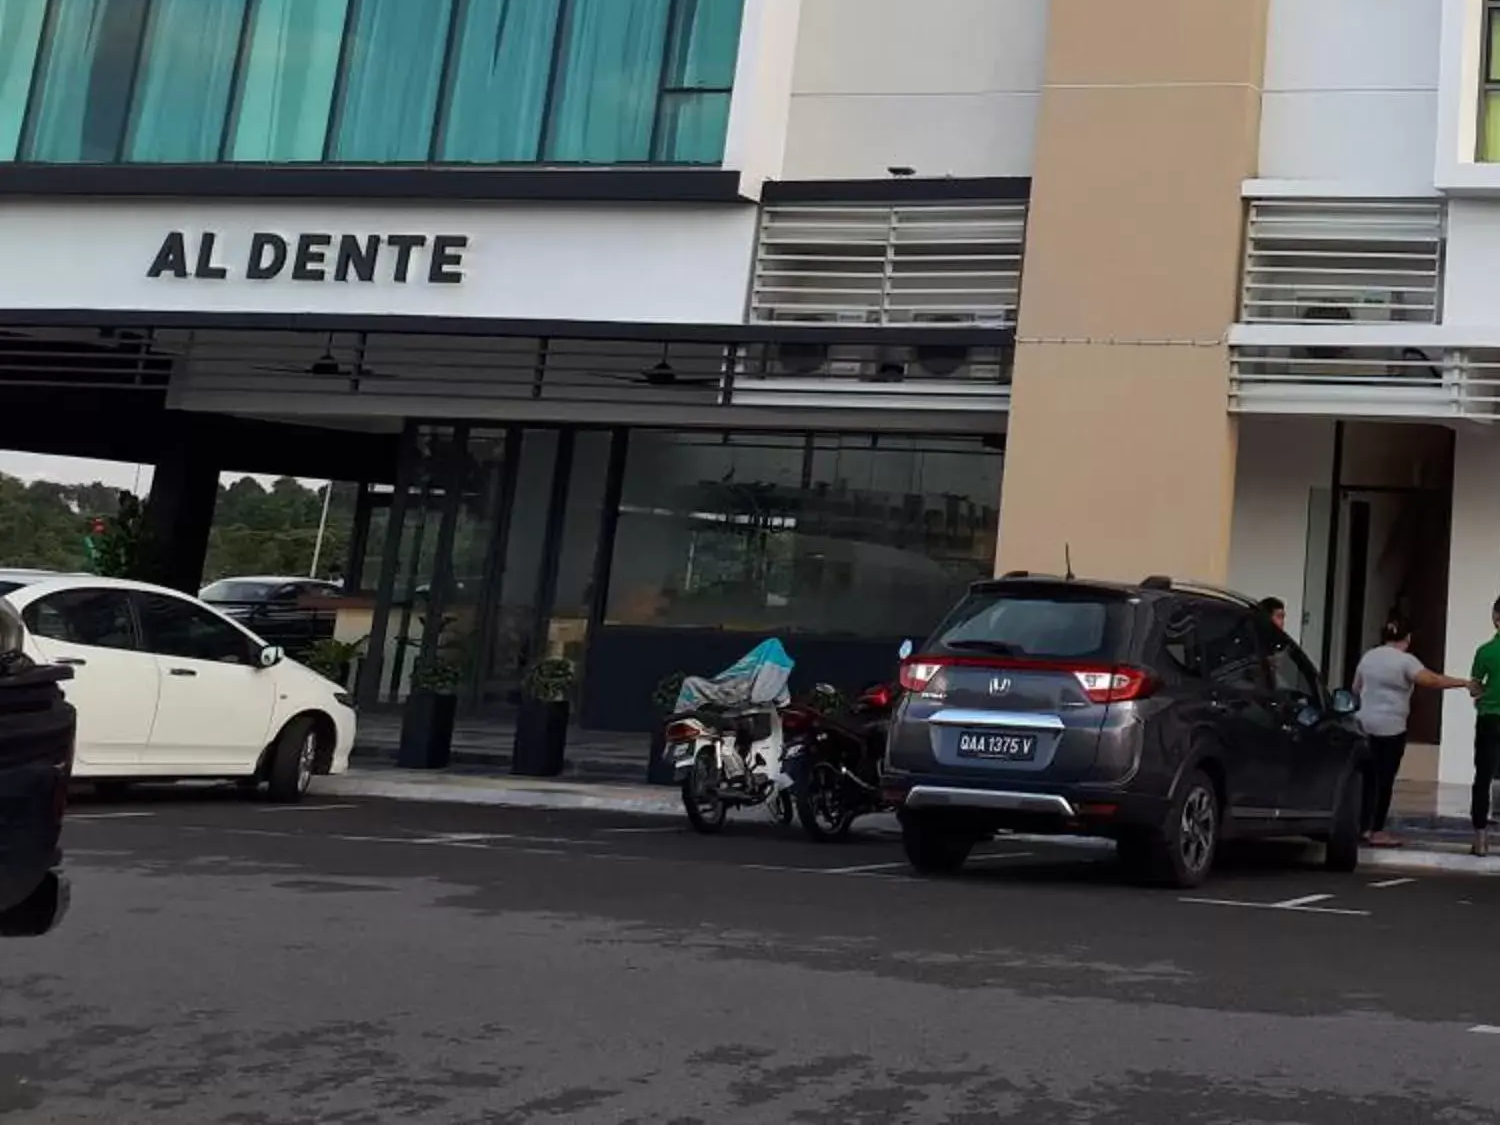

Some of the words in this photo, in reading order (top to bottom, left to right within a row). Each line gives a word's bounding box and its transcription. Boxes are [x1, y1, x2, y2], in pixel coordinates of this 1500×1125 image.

[146, 232, 228, 279] AL
[245, 232, 468, 283] DENTE
[960, 735, 985, 752] QAA
[988, 736, 1019, 754] 1375
[1023, 738, 1032, 754] V
